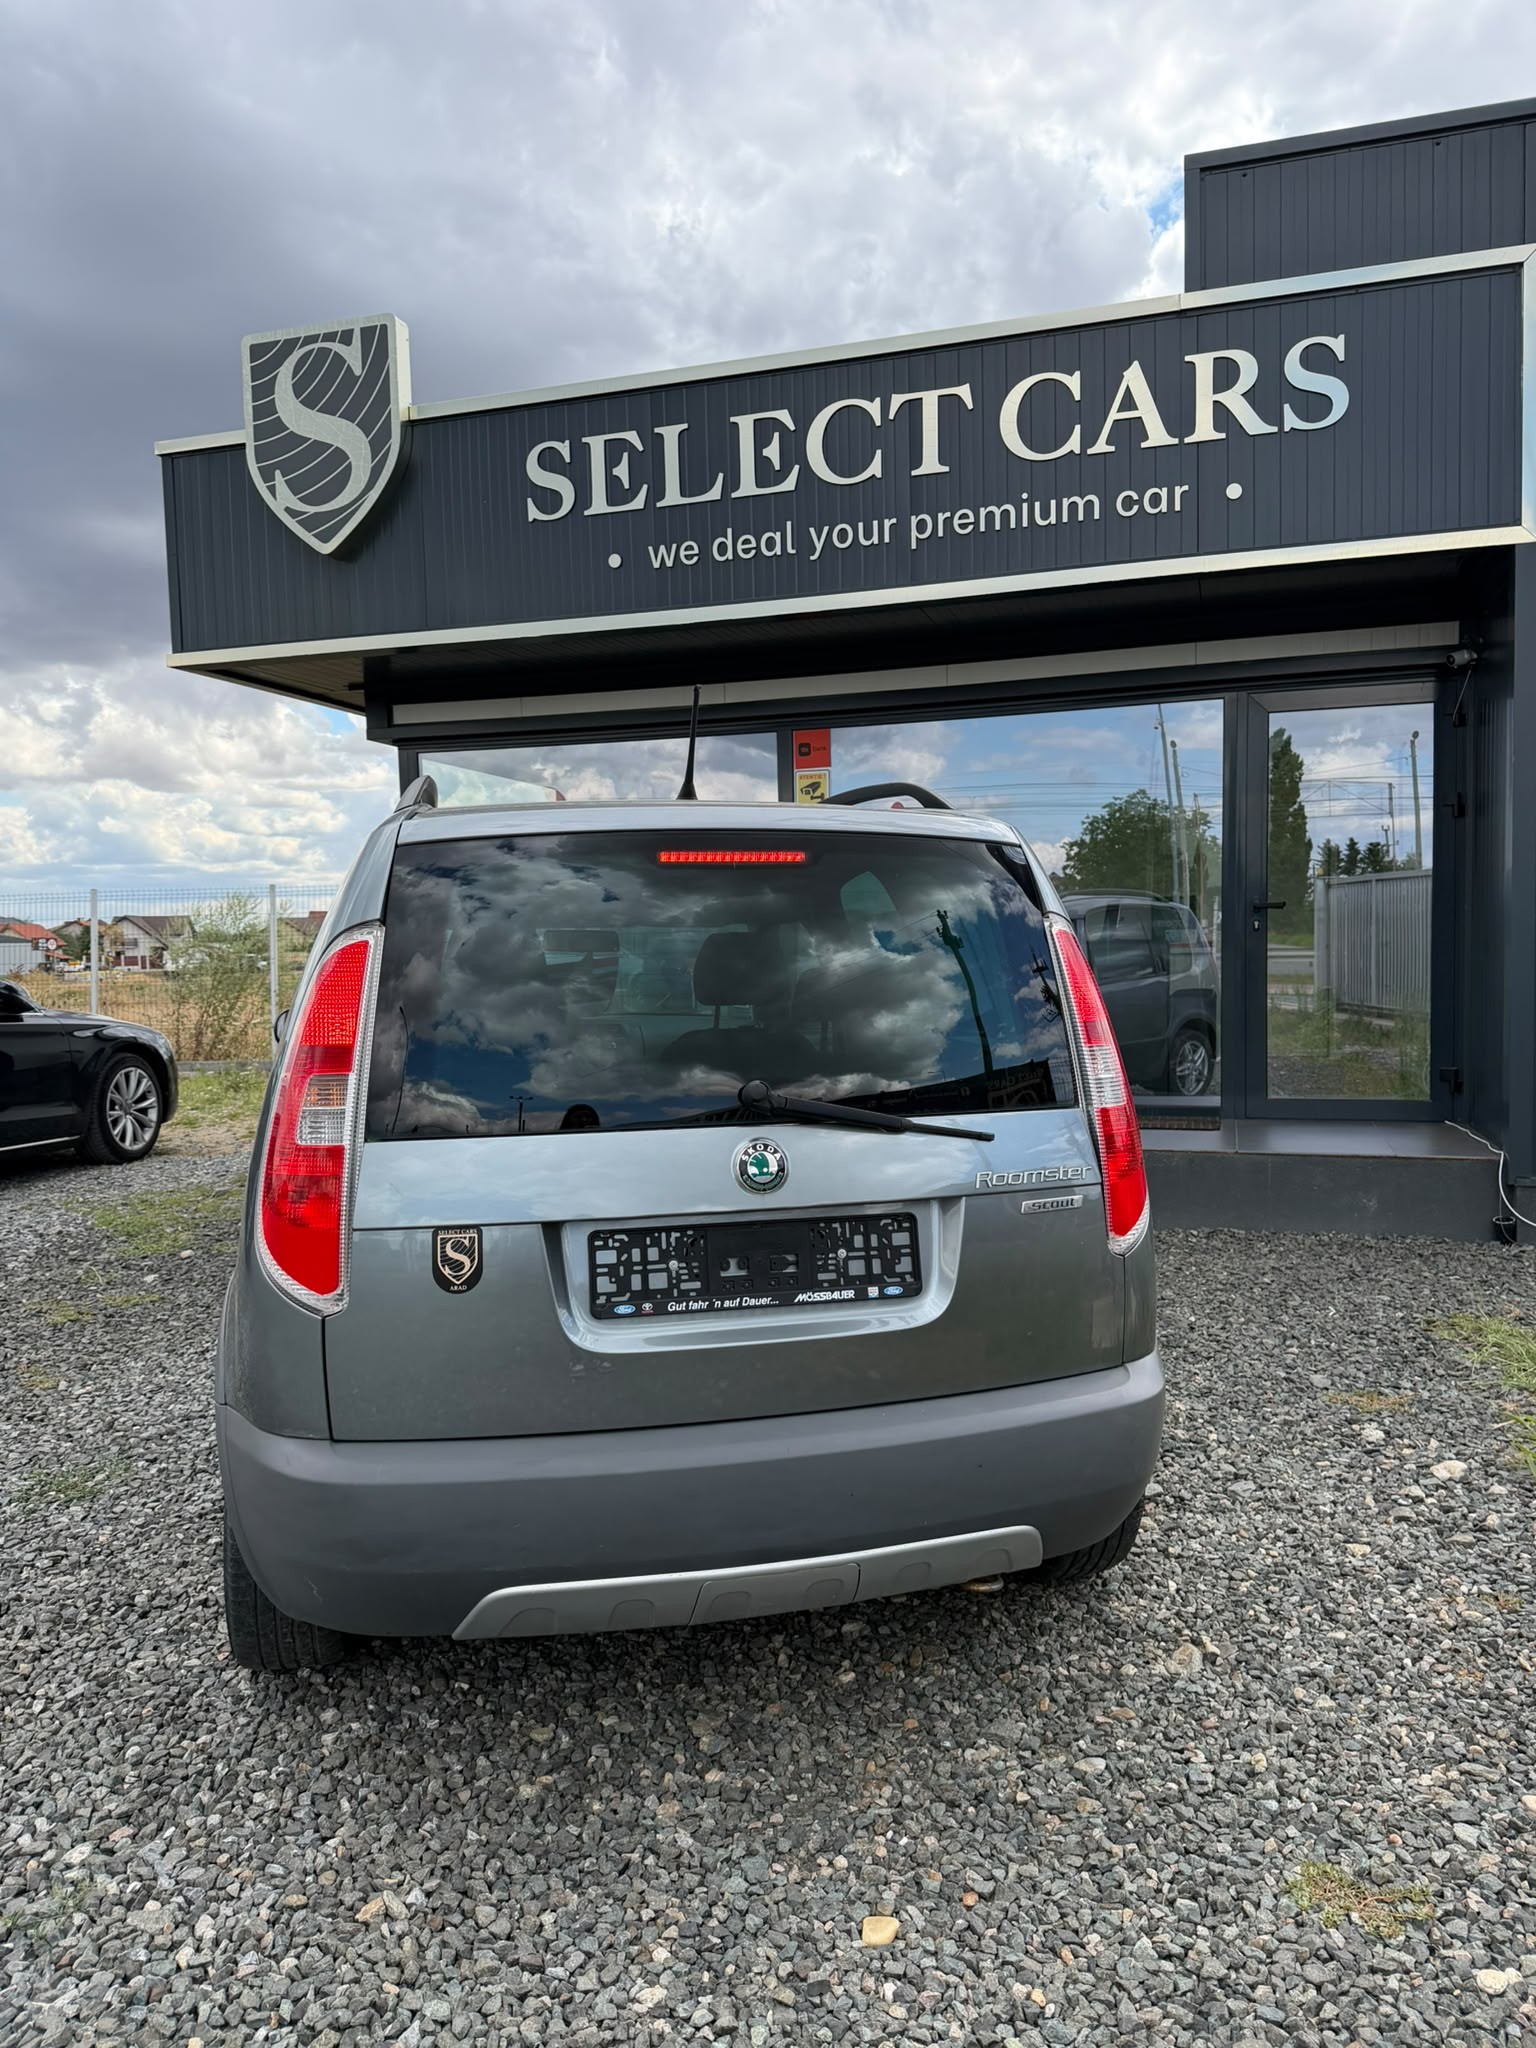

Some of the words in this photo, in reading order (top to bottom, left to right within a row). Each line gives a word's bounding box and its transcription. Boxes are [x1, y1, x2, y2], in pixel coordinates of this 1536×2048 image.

[524, 382, 975, 523] SELECT
[998, 333, 1351, 462] CARS
[647, 541, 700, 569] we
[712, 520, 797, 562] deal
[808, 517, 897, 561] your
[909, 491, 1100, 550] premium
[1115, 483, 1190, 518] car
[975, 1166, 1093, 1189] Roomster
[667, 1302, 686, 1312] Gut
[688, 1300, 709, 1310] fahr
[723, 1297, 740, 1308] auf
[742, 1297, 779, 1306] Dauer...
[794, 1289, 856, 1303] MÖSSBAUER
